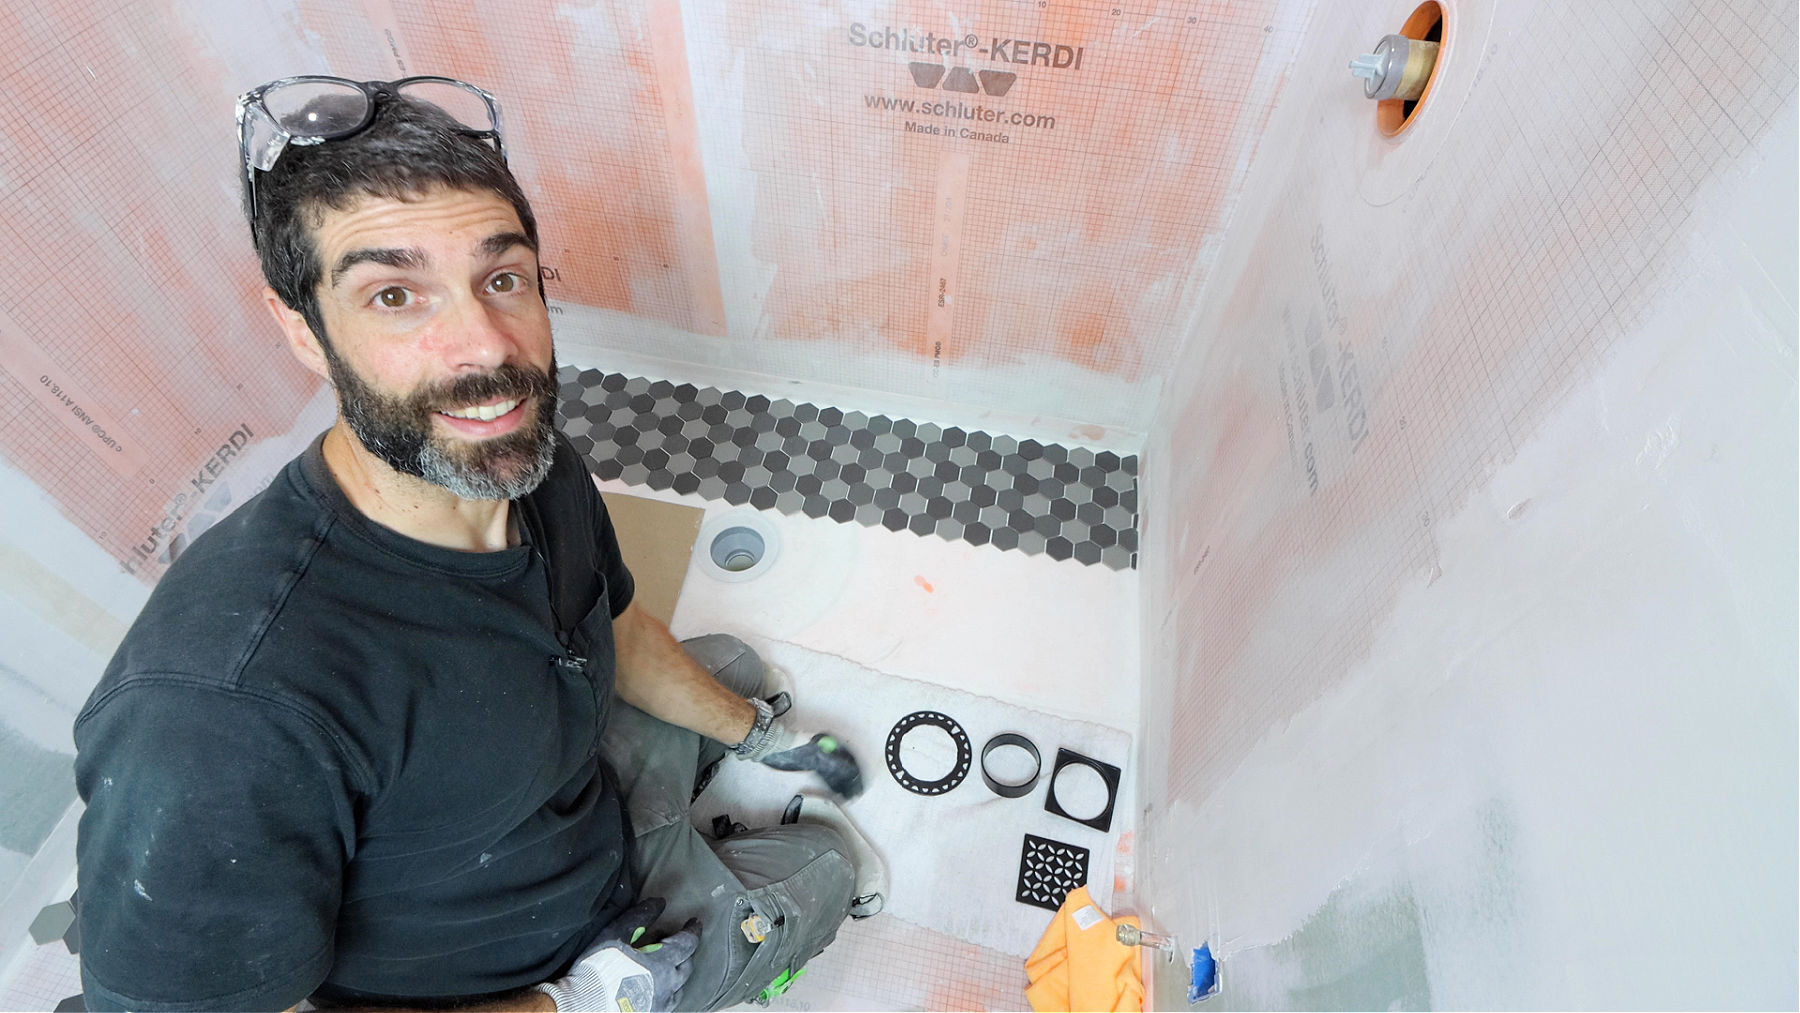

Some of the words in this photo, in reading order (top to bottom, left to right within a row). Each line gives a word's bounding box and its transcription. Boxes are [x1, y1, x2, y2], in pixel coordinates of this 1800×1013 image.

[1037, 0, 1047, 9] 10
[1111, 8, 1122, 16] 20
[1187, 16, 1197, 25] 30
[1263, 24, 1274, 33] 40
[864, 94, 1056, 130] www.schluter.com
[904, 120, 940, 136] Made
[944, 125, 955, 138] in
[959, 127, 1010, 144] Canada
[39, 375, 75, 407] A118.10
[71, 405, 94, 425] ANSI
